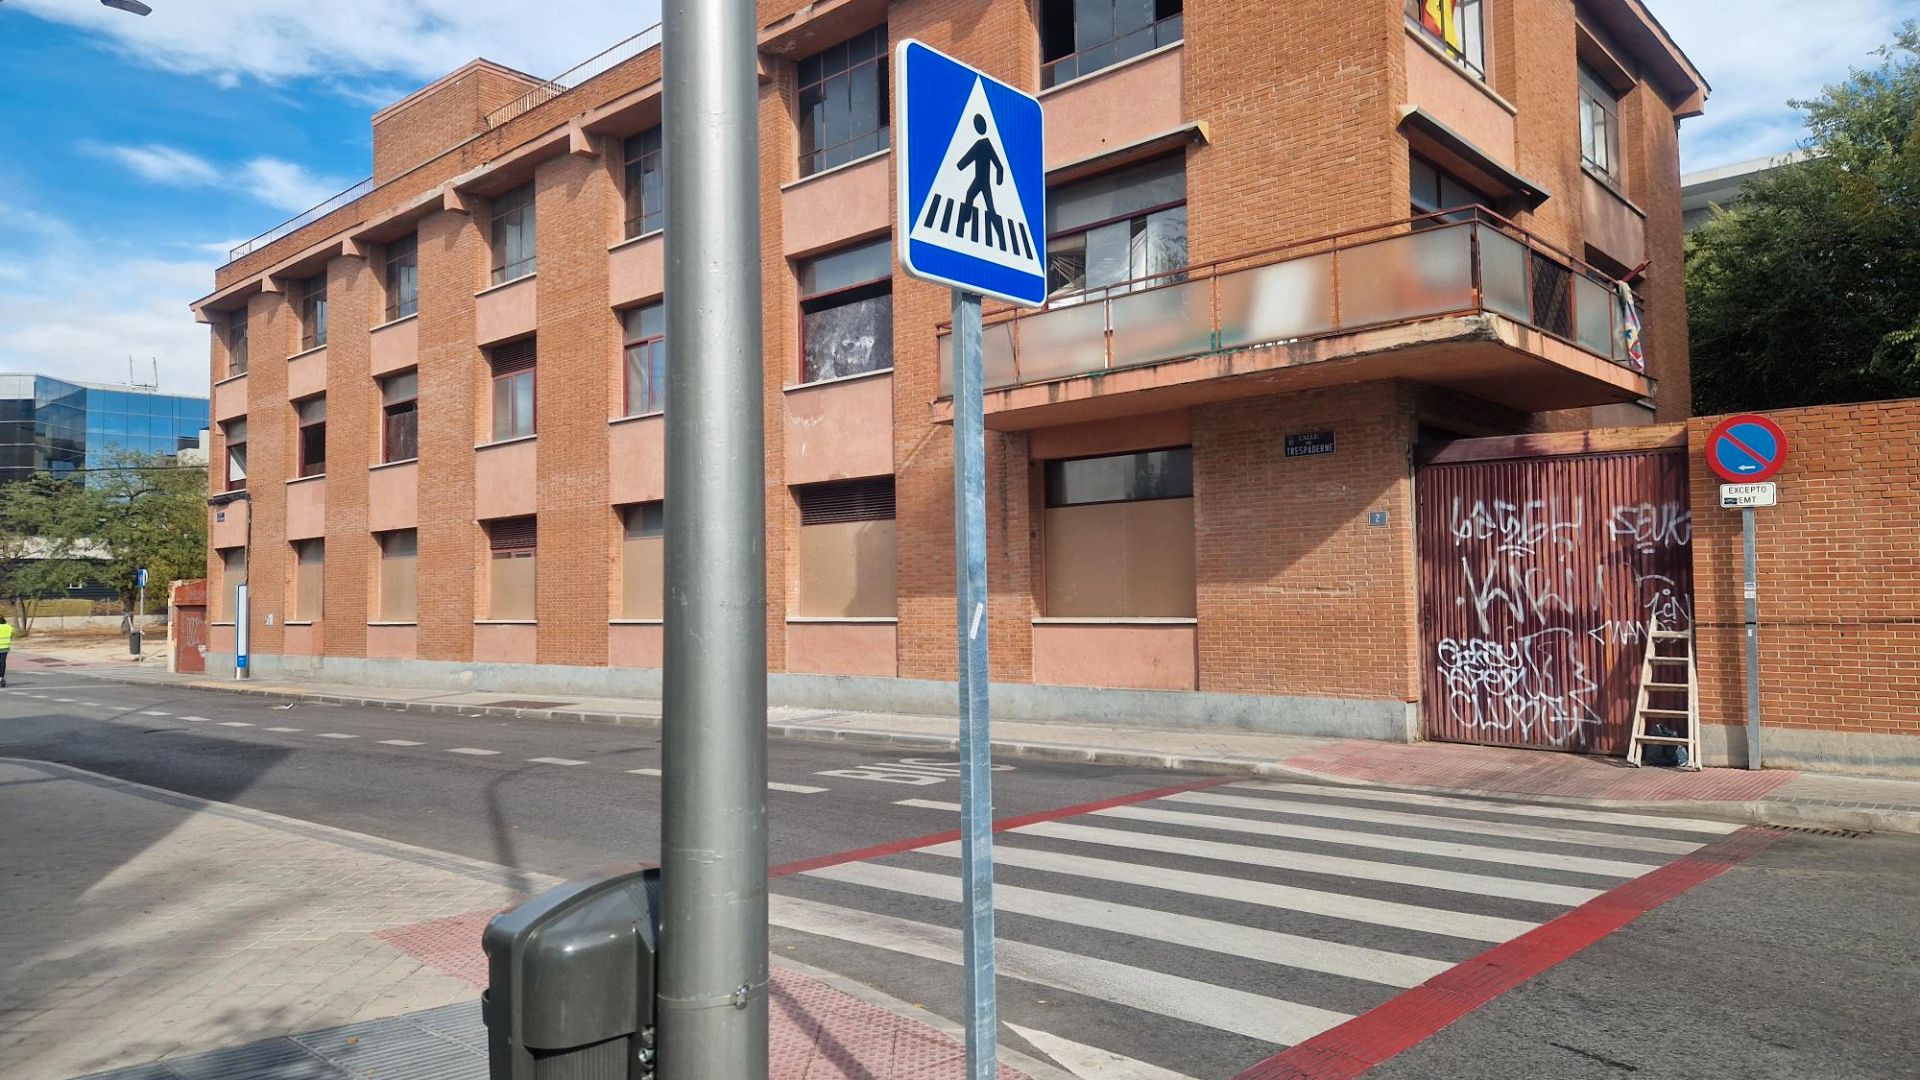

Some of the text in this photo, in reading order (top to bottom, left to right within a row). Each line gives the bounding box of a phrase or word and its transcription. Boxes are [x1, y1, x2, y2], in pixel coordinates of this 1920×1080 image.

[1286, 443, 1334, 456] TRESPADERNE
[1728, 486, 1767, 494] EXCEPTO
[1738, 496, 1757, 504] EMT
[1375, 513, 1380, 522] 2
[812, 758, 1017, 786] BUS
